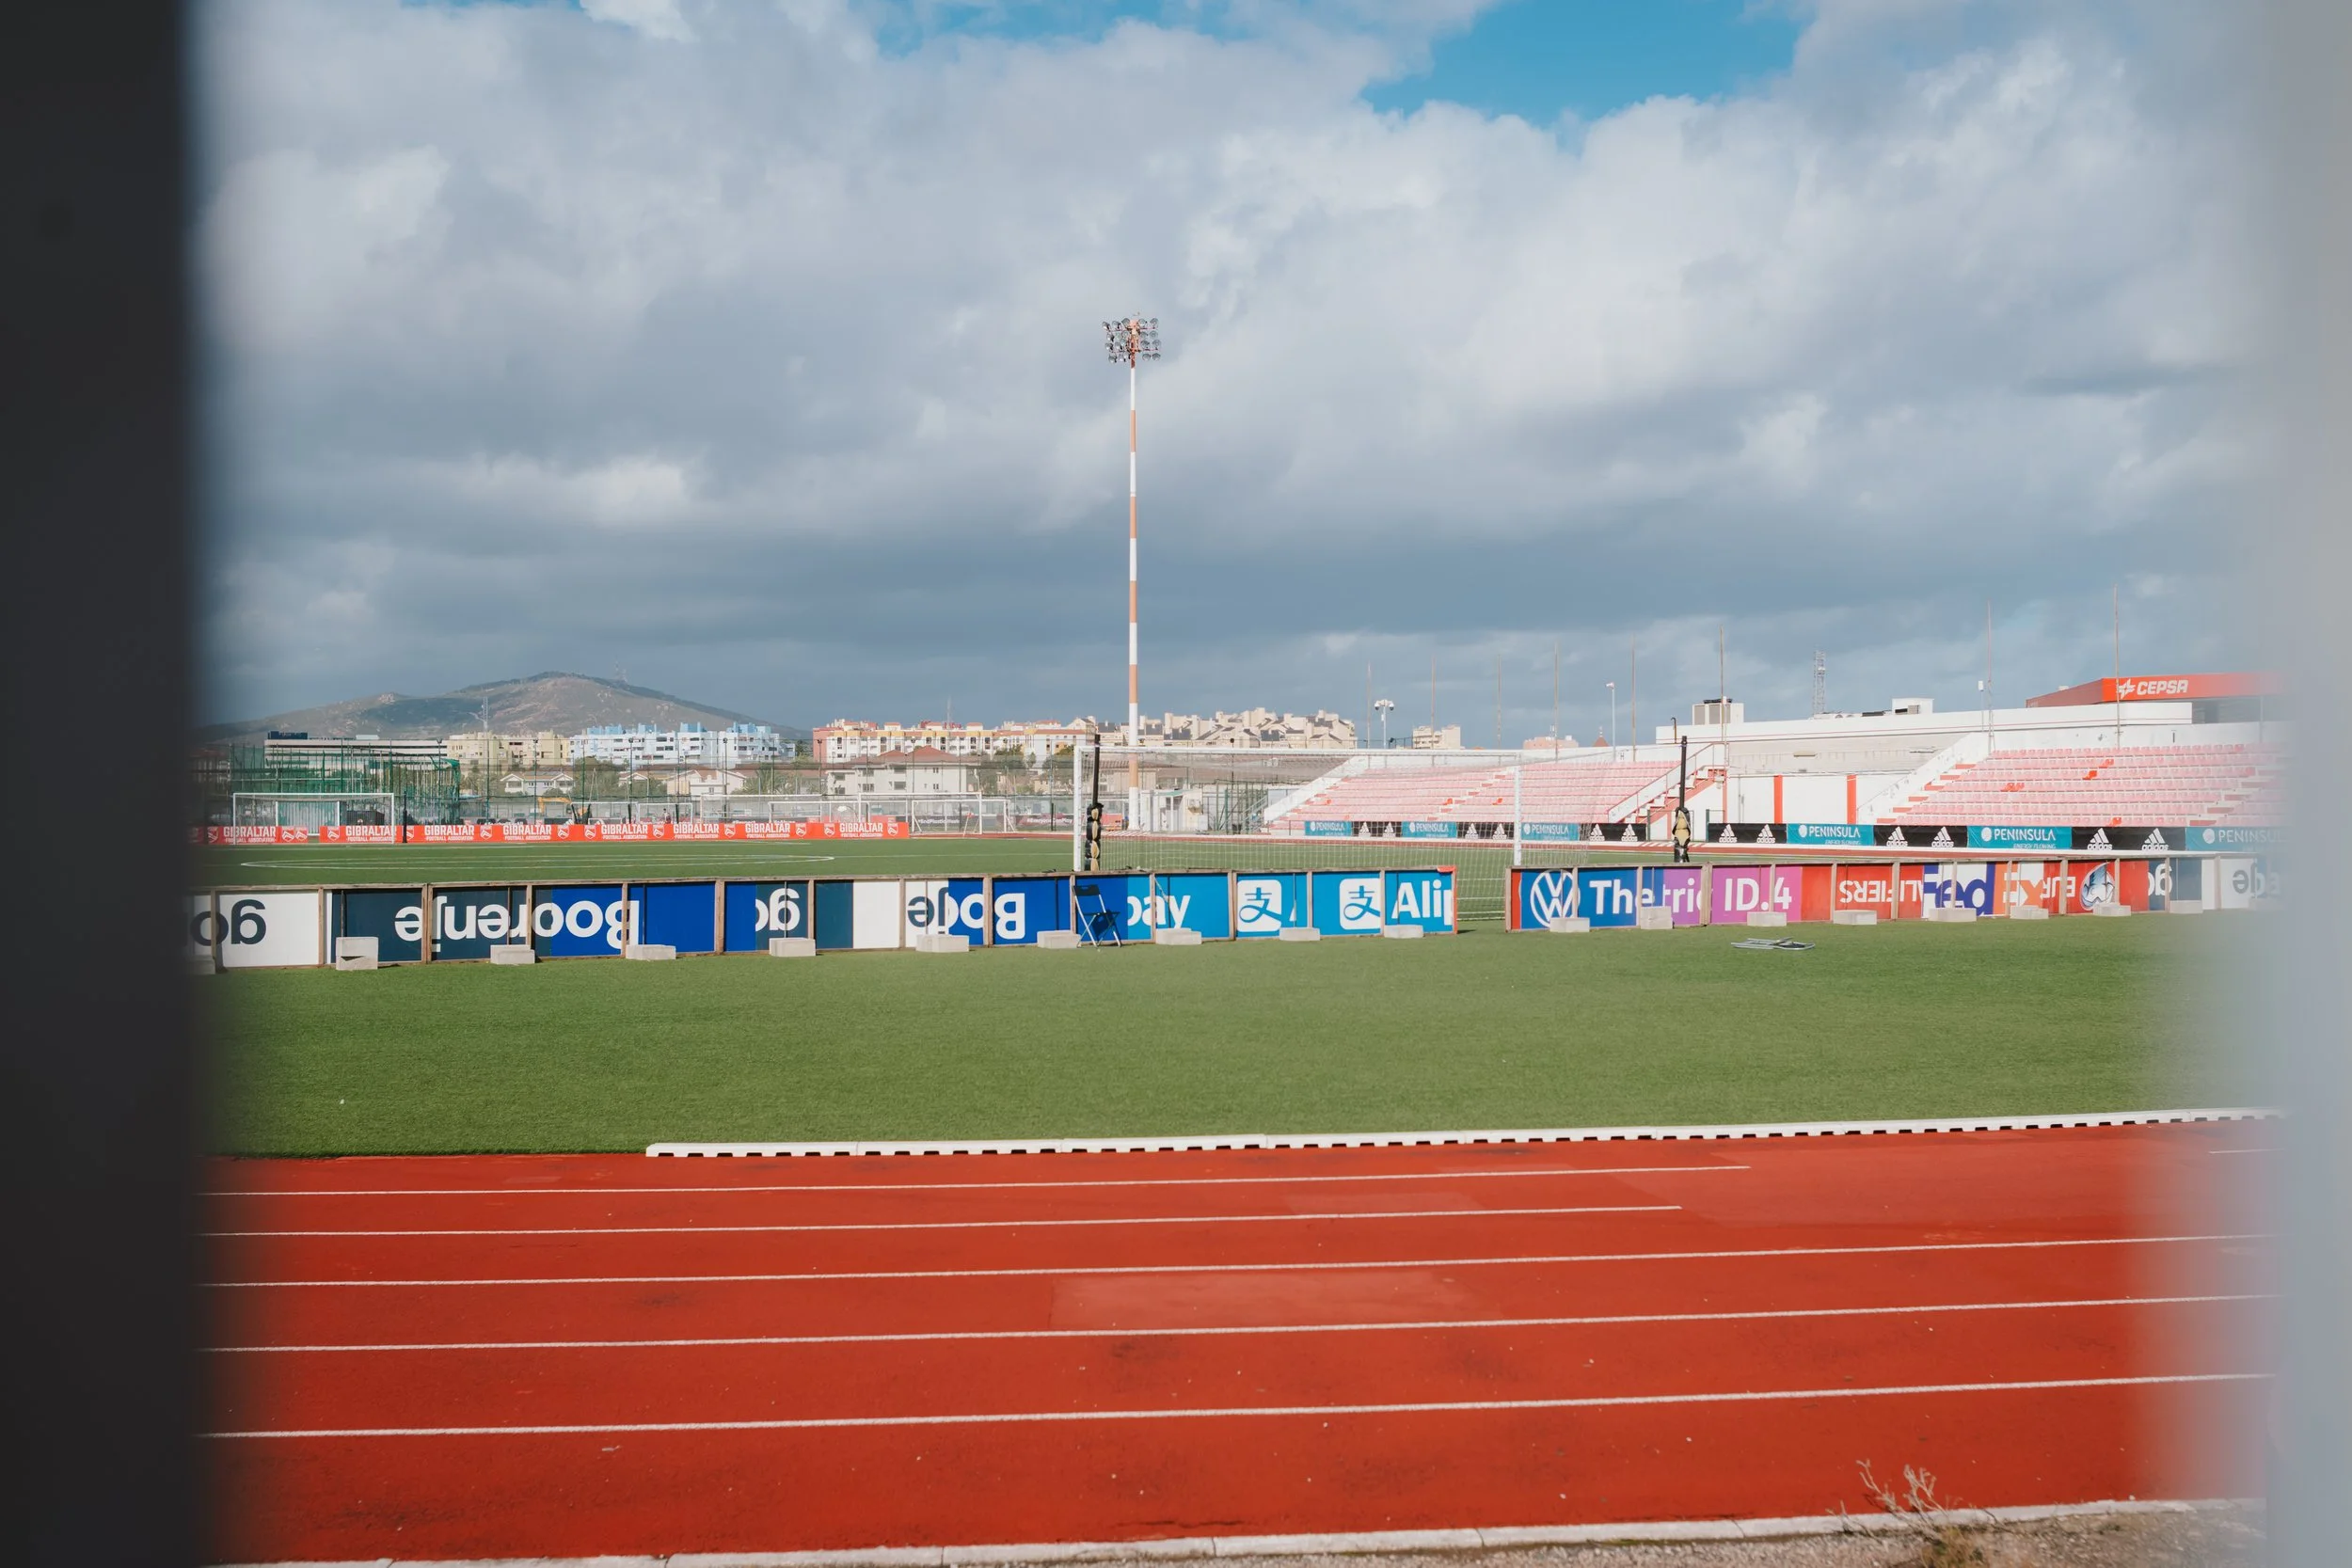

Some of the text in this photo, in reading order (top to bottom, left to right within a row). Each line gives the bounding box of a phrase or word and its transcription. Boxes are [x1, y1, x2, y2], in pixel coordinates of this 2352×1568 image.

[2137, 679, 2189, 695] CEPSA
[223, 826, 276, 837] GIBRALTAR
[345, 825, 397, 836] GIBRALTAR
[424, 825, 474, 835] GIBRALTAR
[502, 824, 551, 835] GIBRALTAR
[601, 824, 648, 834] GIBRALTAR
[673, 823, 719, 833] GIBRALTAR
[744, 823, 790, 833] GIBRALTAR
[839, 822, 883, 832] GIBRALTAR
[1415, 822, 1449, 832] PENINSULA
[1532, 824, 1569, 834] PENINSULA
[1808, 826, 1861, 838] PENINSULA
[1994, 829, 2057, 841] PENINSULA
[2217, 830, 2280, 843] PENINSUL
[1589, 879, 1656, 915] The
[1724, 877, 1792, 911] ID.4
